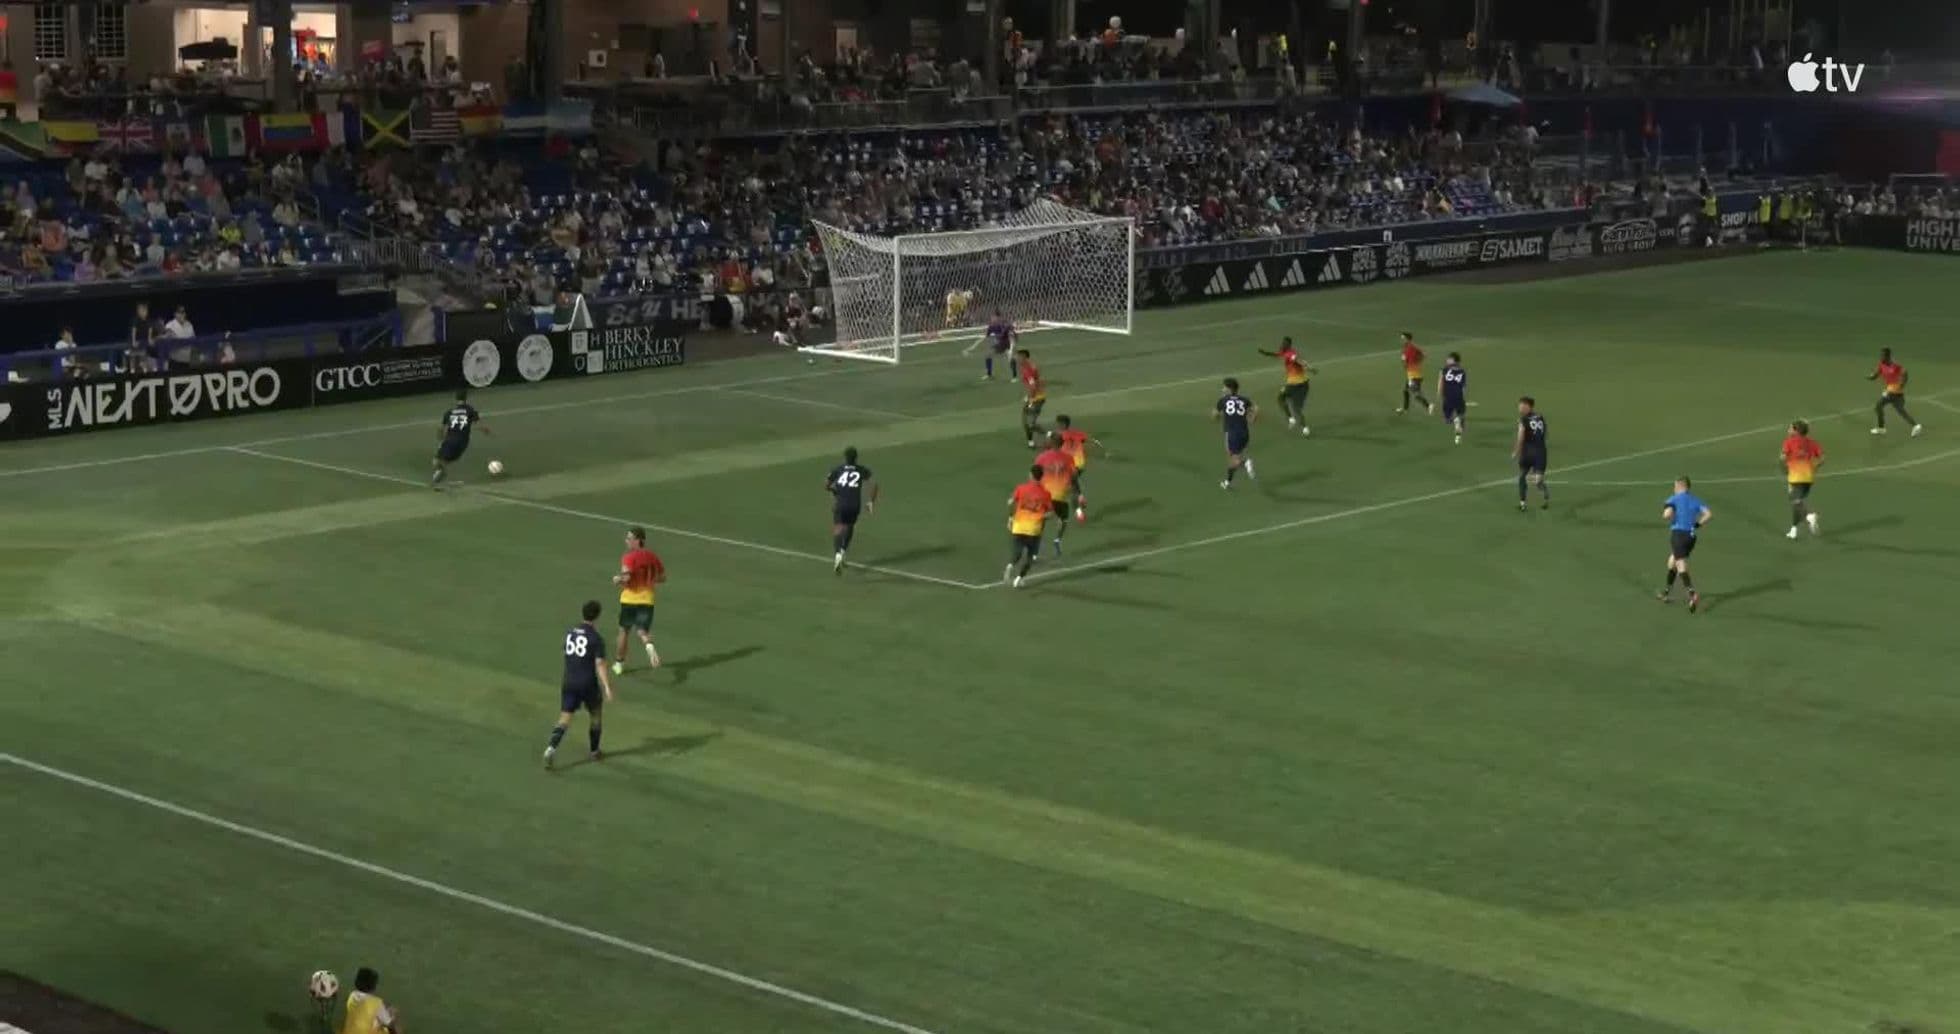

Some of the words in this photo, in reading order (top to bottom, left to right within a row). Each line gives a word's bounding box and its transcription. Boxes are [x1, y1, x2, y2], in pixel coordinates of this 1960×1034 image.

[1906, 217, 1954, 237] HIGH
[1499, 236, 1544, 259] SAMET
[605, 326, 654, 345] BERKY
[605, 337, 682, 361] HINCKLEY
[315, 363, 381, 392] GTCC
[1445, 370, 1463, 383] 64
[48, 387, 62, 430] MLS
[64, 377, 164, 428] NEXT
[203, 366, 281, 411] PRO
[1225, 400, 1246, 416] 83
[449, 414, 468, 431] 77
[1529, 419, 1545, 435] 99
[837, 471, 861, 488] 42
[565, 633, 589, 658] 68
